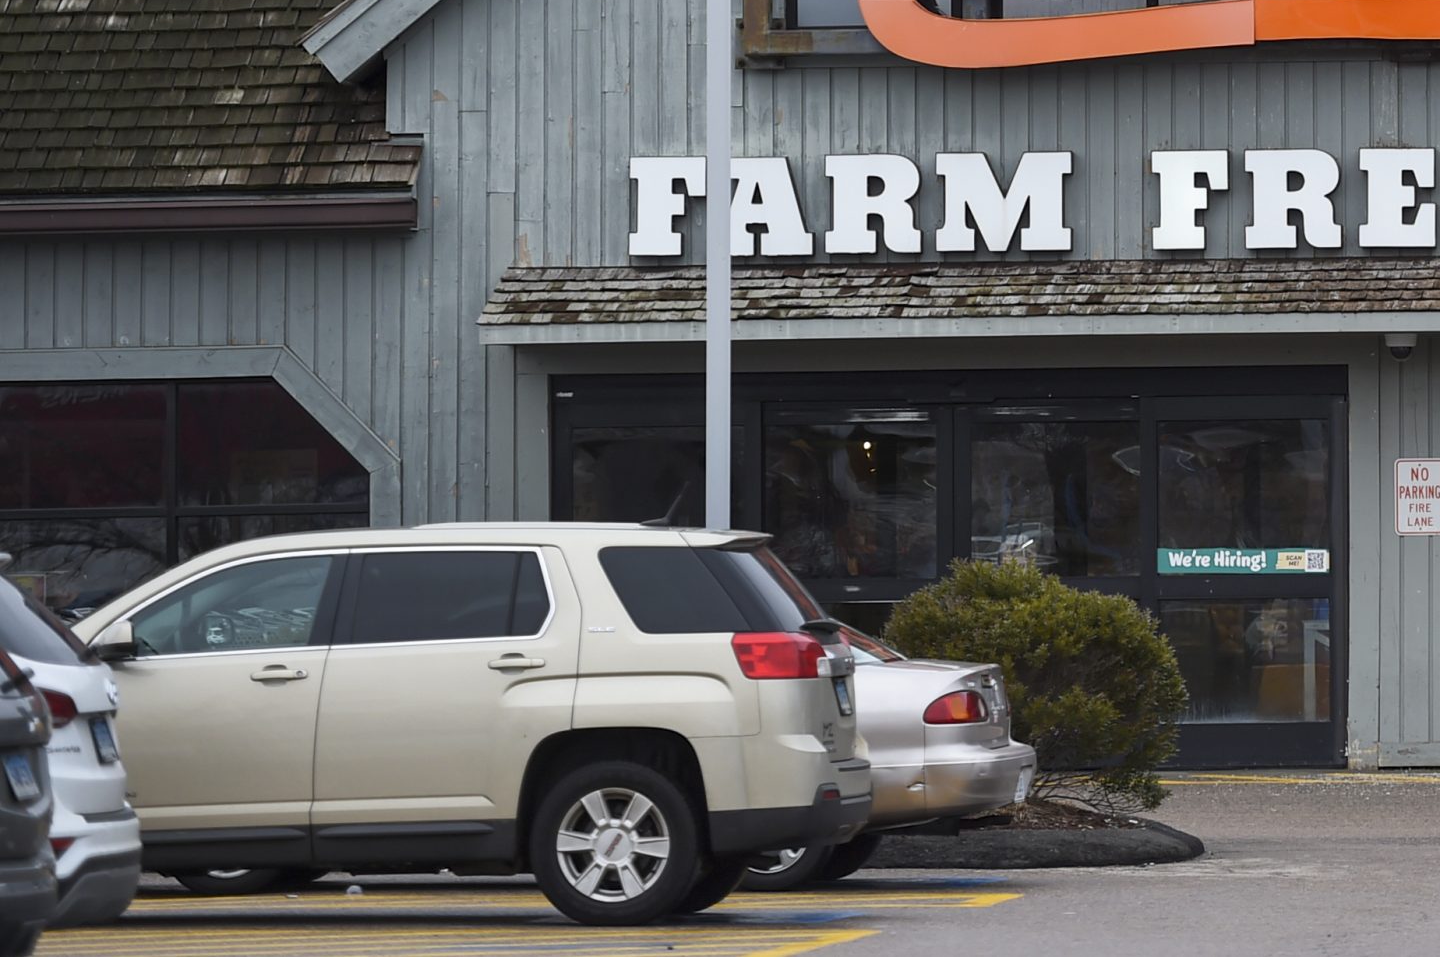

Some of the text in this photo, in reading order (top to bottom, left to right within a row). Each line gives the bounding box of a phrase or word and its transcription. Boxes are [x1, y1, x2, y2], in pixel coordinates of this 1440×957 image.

[628, 150, 1073, 257] FARM
[1410, 467, 1429, 481] NO
[1408, 503, 1432, 513] FIRE
[1407, 516, 1434, 526] LANE
[1168, 550, 1267, 572] We're Hiring!
